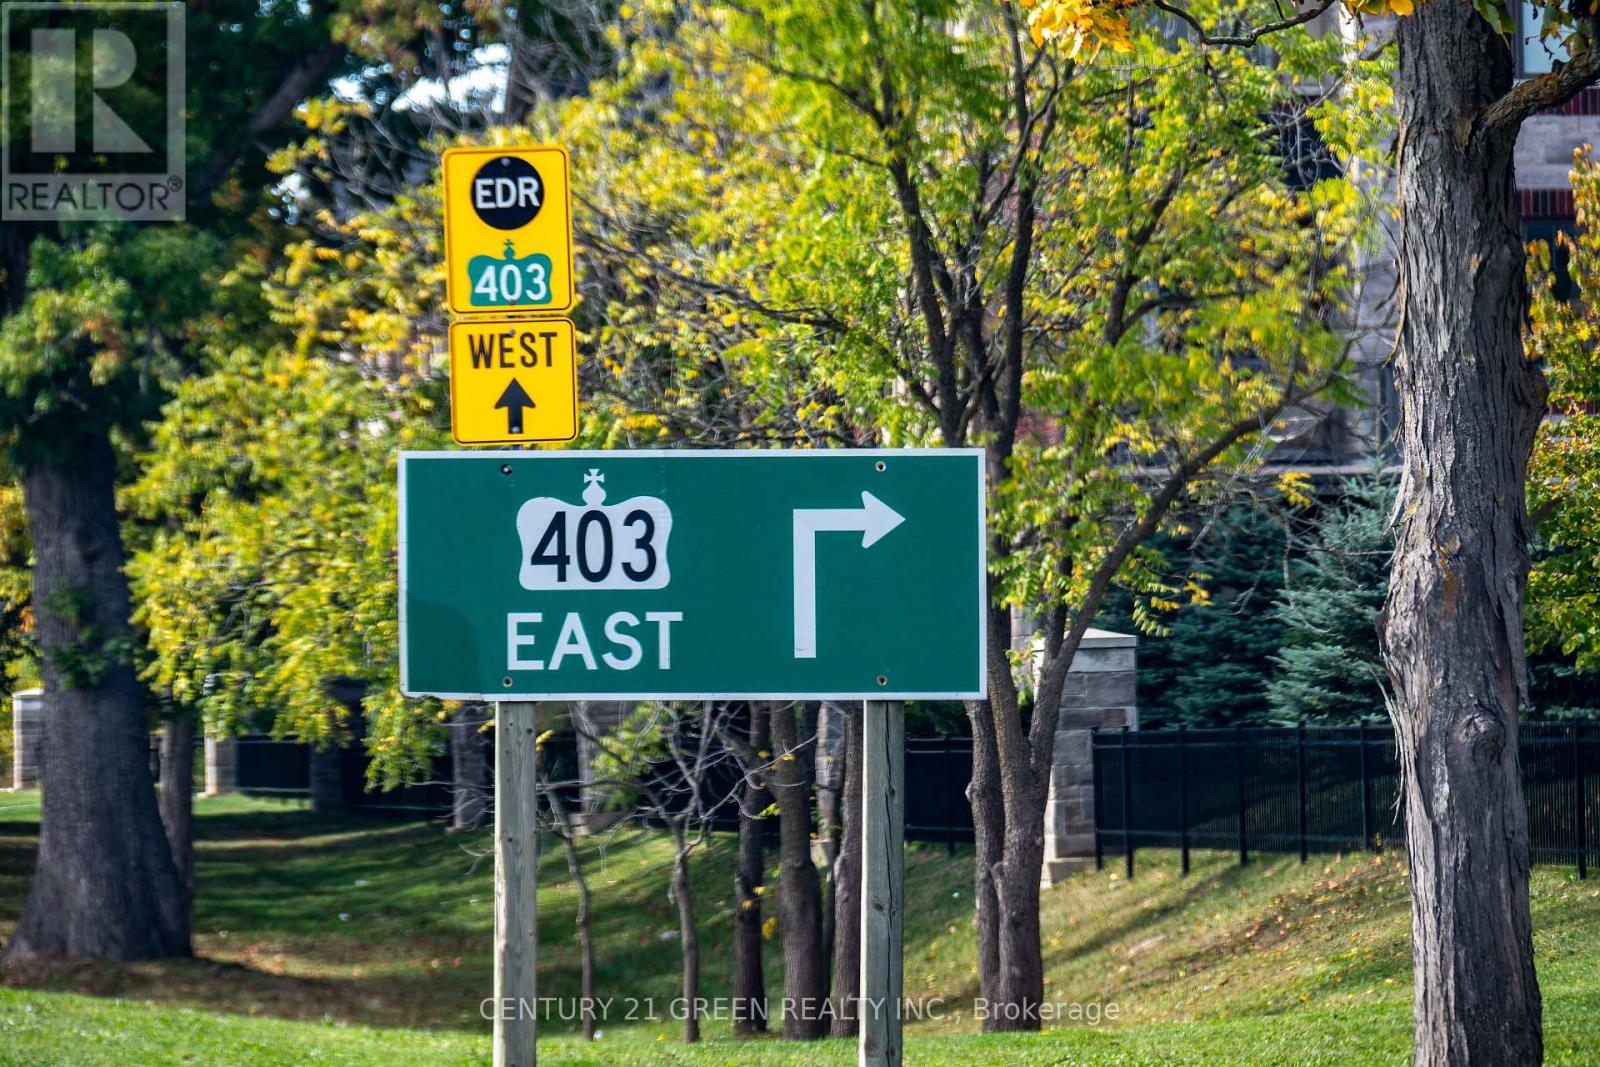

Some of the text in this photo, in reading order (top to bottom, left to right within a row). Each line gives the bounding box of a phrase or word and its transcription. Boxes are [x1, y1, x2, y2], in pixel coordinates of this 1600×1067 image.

[475, 176, 540, 209] EDR
[474, 263, 547, 302] 403
[468, 331, 558, 369] WEST
[530, 509, 657, 583] 403
[506, 611, 684, 671] EAST
